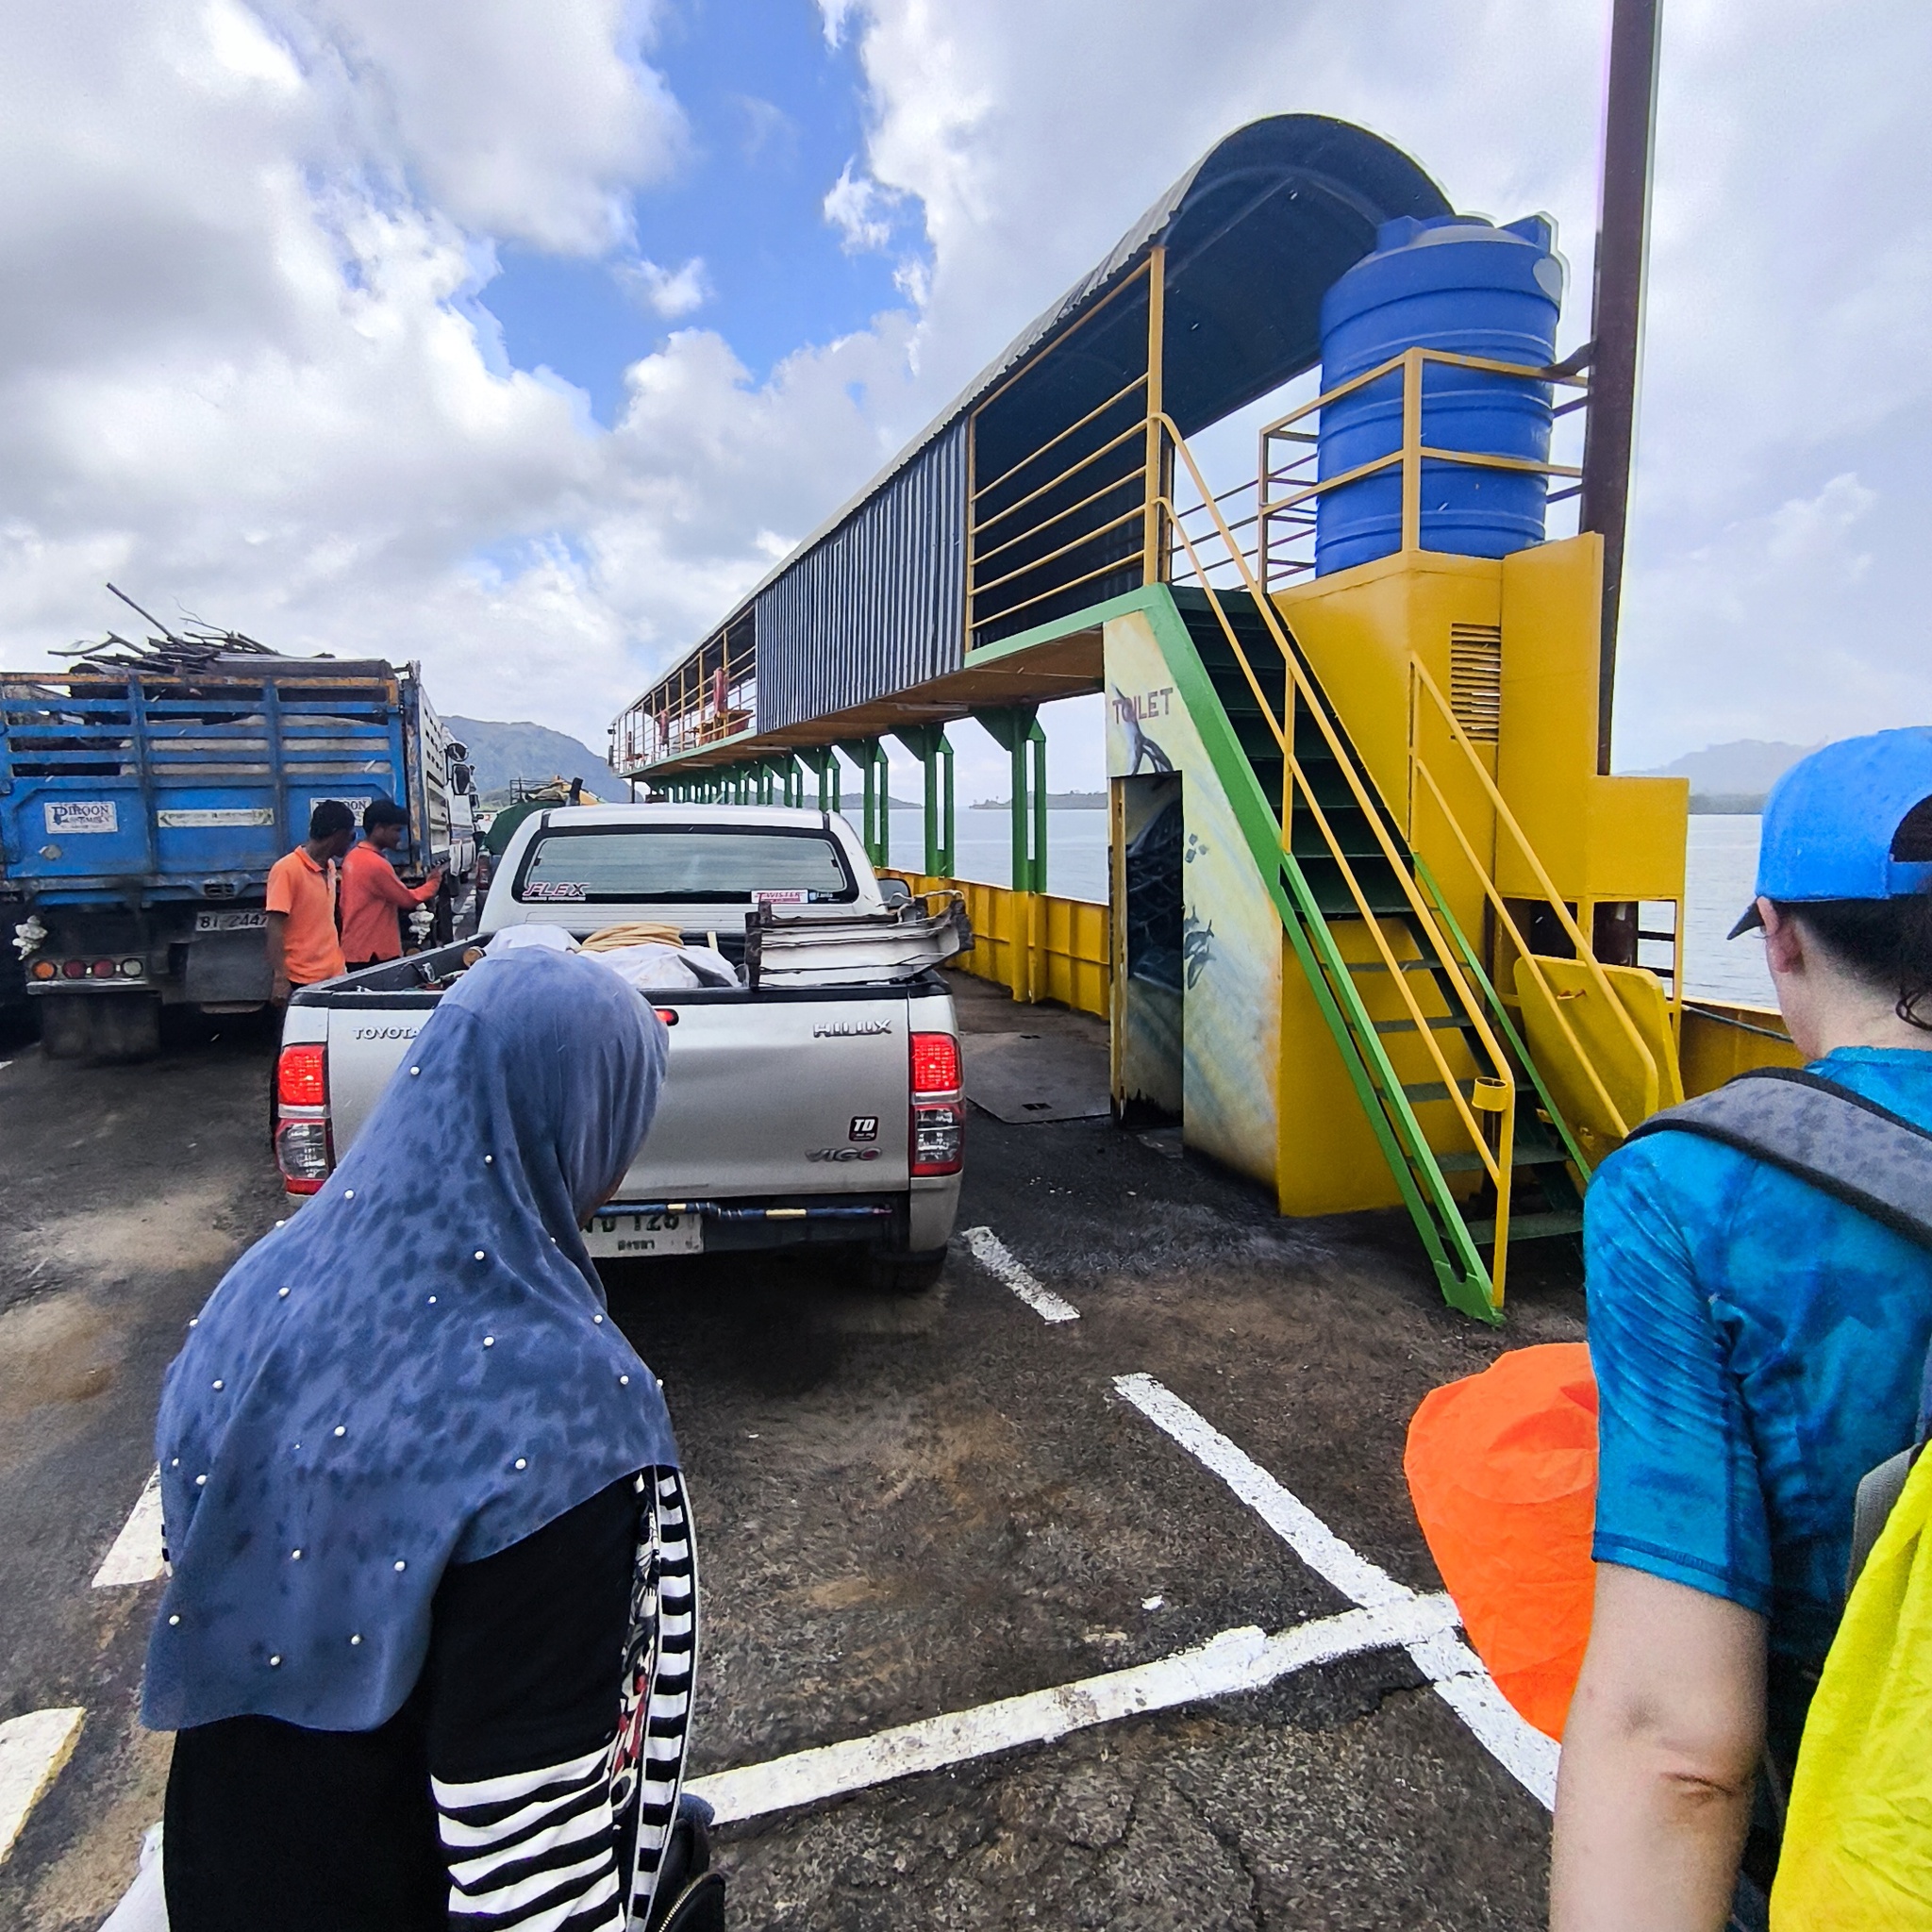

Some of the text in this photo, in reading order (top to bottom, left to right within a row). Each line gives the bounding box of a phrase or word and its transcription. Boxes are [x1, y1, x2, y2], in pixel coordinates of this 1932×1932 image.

[1111, 687, 1174, 725] TOILET
[522, 881, 590, 896] FLEX
[756, 891, 802, 903] TWISTER
[353, 1026, 421, 1040] TOYOTA
[813, 1019, 892, 1038] HILUX
[854, 1119, 875, 1132] TD
[805, 1146, 883, 1162] VIGO
